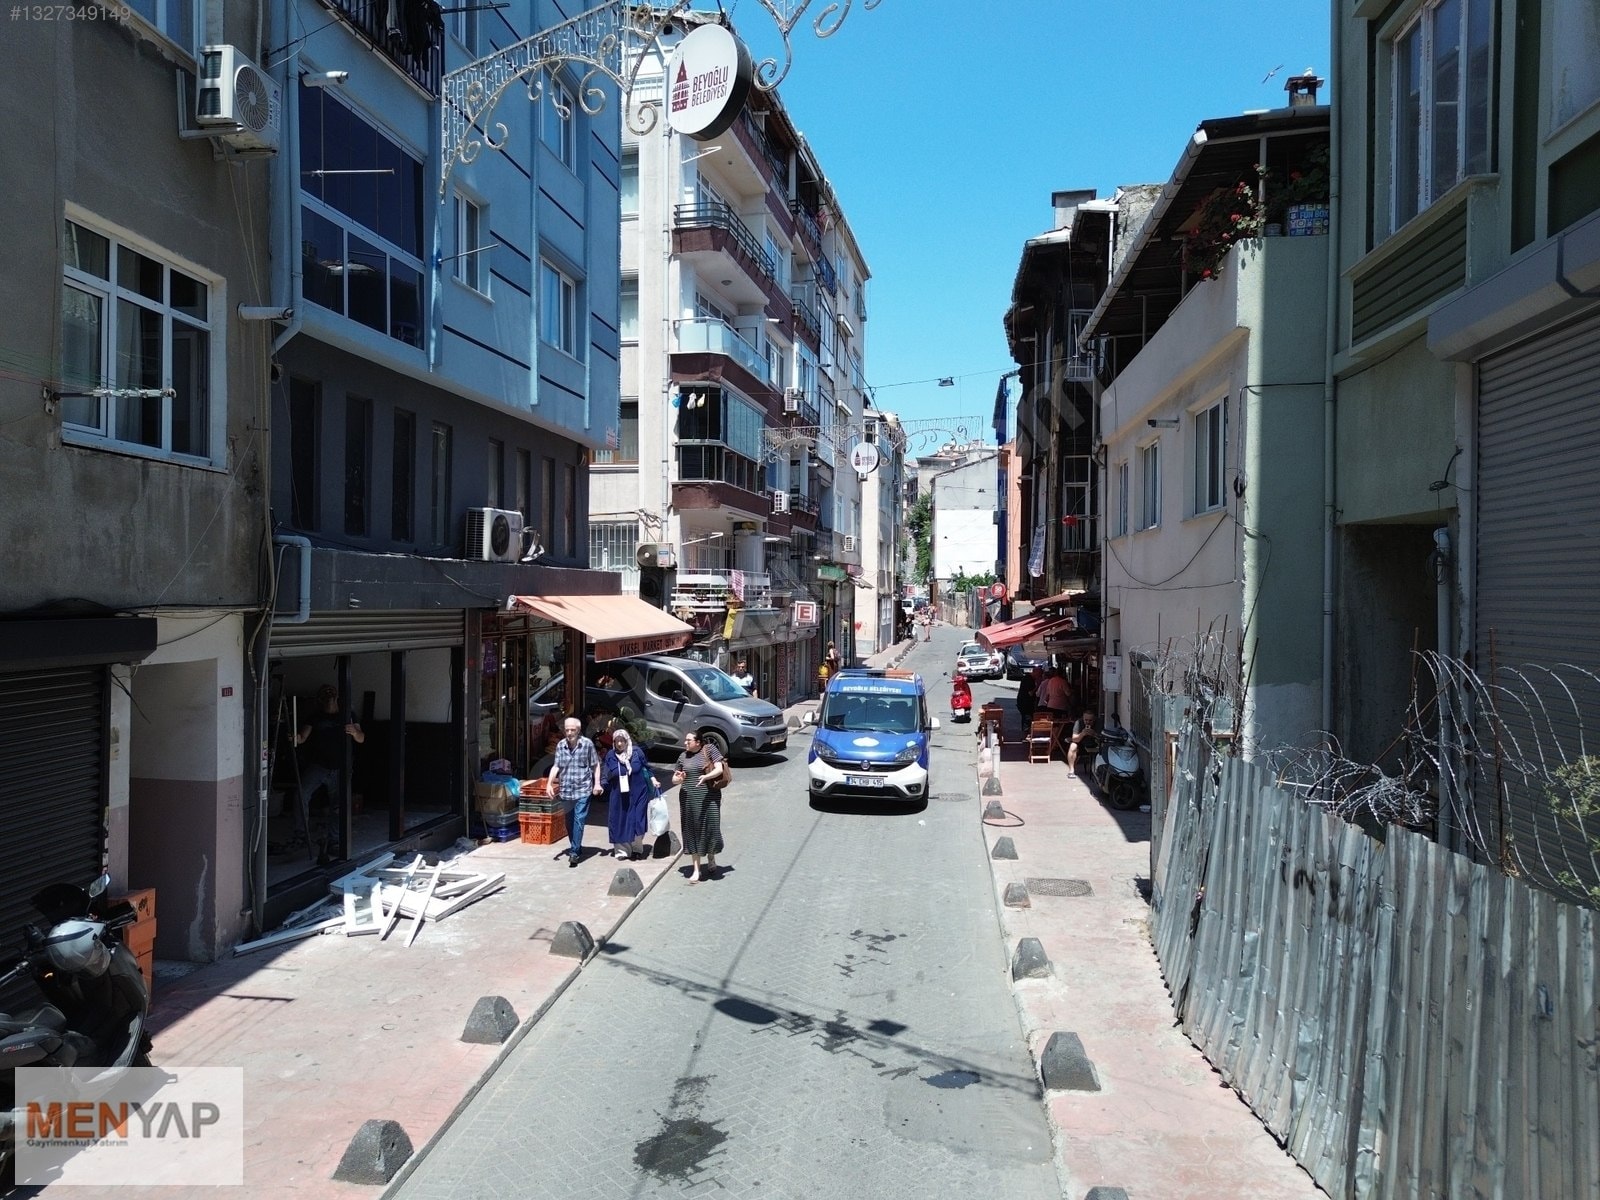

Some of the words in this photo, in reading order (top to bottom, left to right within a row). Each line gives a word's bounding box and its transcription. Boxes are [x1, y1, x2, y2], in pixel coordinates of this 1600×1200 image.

[693, 66, 728, 93] BEYOĞLU
[692, 84, 727, 107] BELEDİYESİ
[1315, 210, 1328, 218] BOX
[800, 606, 811, 619] E
